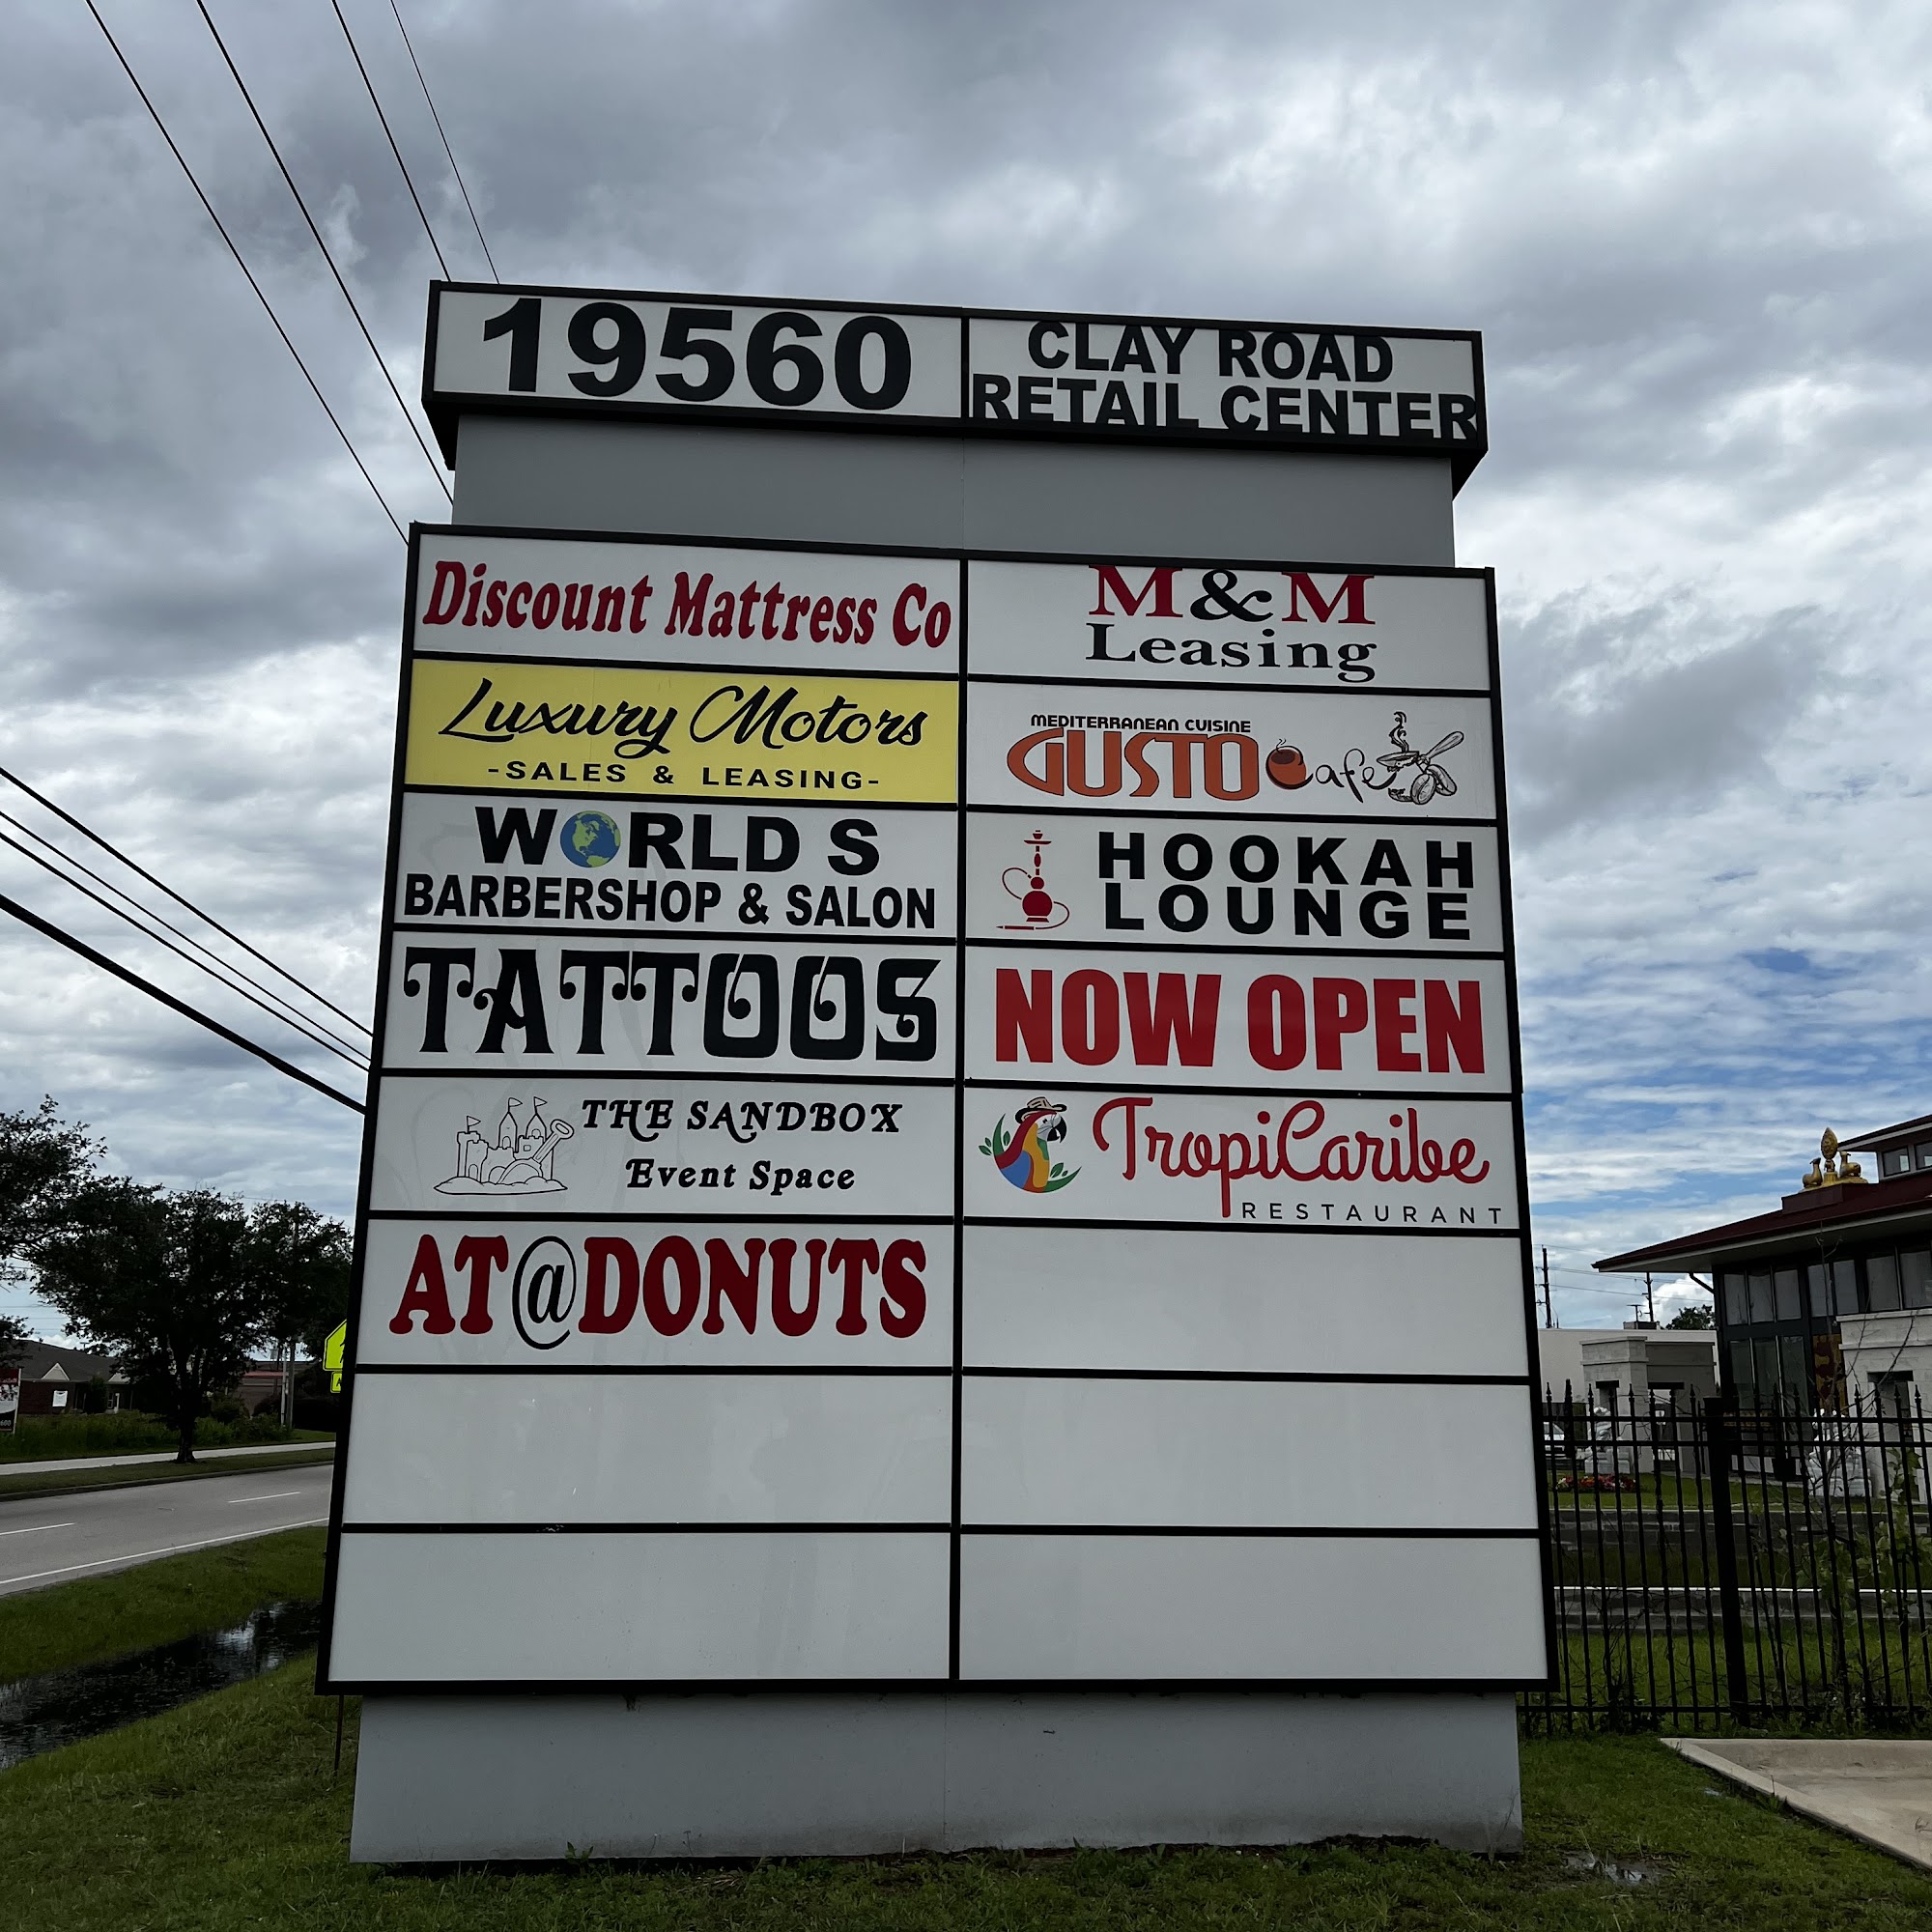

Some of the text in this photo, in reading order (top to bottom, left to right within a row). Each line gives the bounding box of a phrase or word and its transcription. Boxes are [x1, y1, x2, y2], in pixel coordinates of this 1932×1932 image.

[483, 298, 912, 411] 19560
[1028, 321, 1394, 384] CLAY ROAD
[973, 373, 1478, 441] RETAIL CENTER
[423, 560, 952, 648] Discount Mattress Co
[1088, 564, 1376, 625] M&M
[1085, 622, 1377, 684] Leasing
[438, 677, 928, 759] Luxury Motors
[1031, 714, 1251, 733] MEDITERRANEAN CUISINE
[653, 765, 674, 784] &
[1007, 726, 1260, 801] GUSTO
[1098, 831, 1475, 889] HOOKAH
[404, 873, 935, 929] BARBERSHOP & SALON
[1105, 883, 1471, 941] LOUNGE
[403, 946, 942, 1062] TATTOOS
[996, 968, 1486, 1074] NOW OPEN
[582, 1099, 902, 1144] THE SANDBOX
[625, 1159, 856, 1196] Event Space
[1093, 1096, 1491, 1218] TropiCaribe
[1241, 1202, 1502, 1225] RESTAURANT
